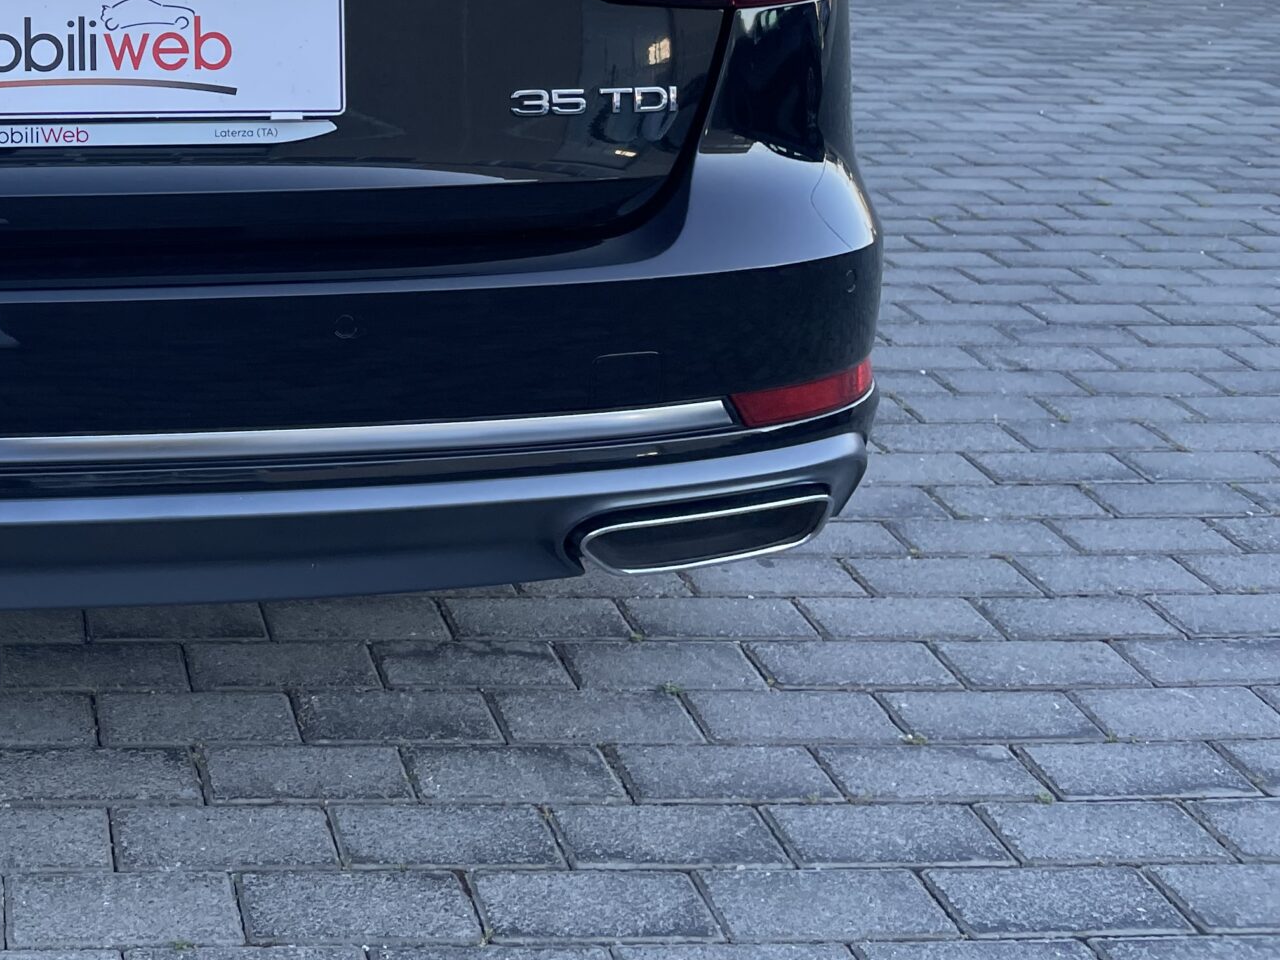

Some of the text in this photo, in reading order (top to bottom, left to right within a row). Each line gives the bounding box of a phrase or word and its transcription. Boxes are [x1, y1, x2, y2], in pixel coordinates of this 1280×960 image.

[510, 85, 678, 116] 35 TDI
[214, 127, 278, 138] Laterza (TA)
